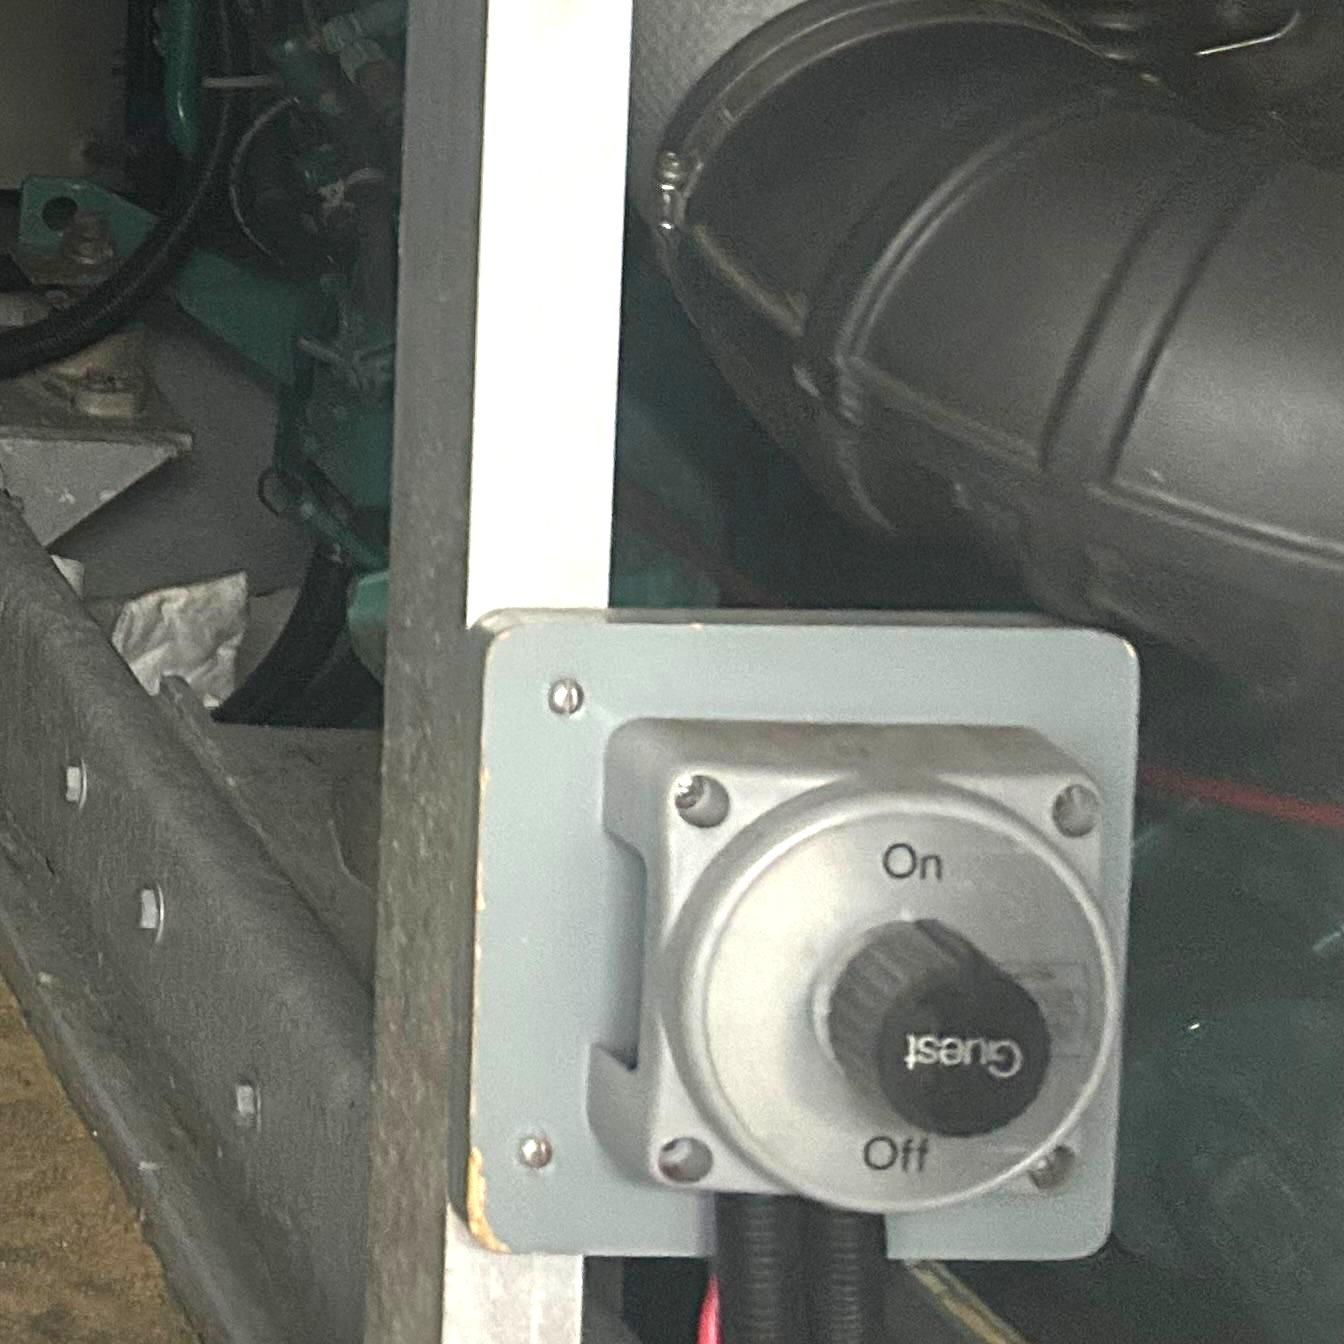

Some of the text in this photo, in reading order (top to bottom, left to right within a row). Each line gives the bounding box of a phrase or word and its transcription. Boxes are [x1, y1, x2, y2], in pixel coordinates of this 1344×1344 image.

[883, 843, 943, 880] On
[903, 1034, 1023, 1078] Guest
[863, 1136, 929, 1172] Off
